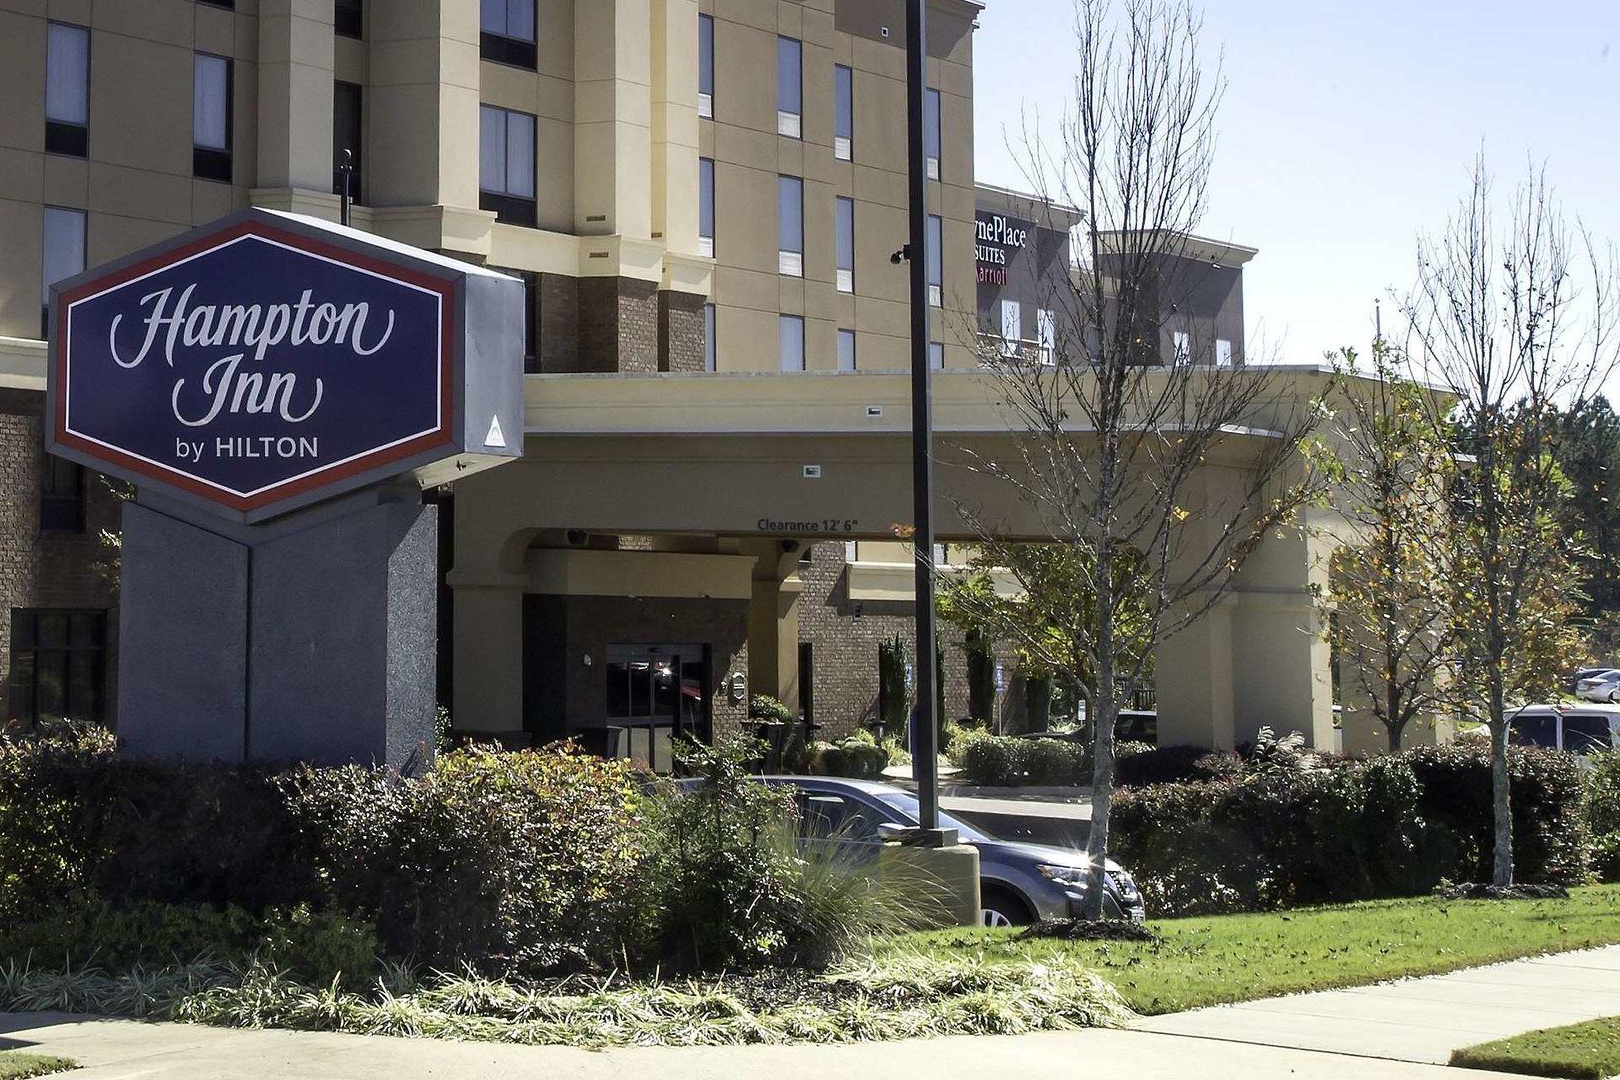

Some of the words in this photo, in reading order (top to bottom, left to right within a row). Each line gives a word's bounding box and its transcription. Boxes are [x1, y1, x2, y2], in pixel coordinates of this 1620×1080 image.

[975, 266, 1008, 286] arriott
[110, 283, 395, 369] Hampton
[172, 354, 323, 427] Inn
[176, 437, 204, 463] by
[216, 437, 318, 458] HILTON
[757, 518, 819, 532] Clearance
[822, 519, 840, 532] 12'
[844, 519, 859, 532] 6"
